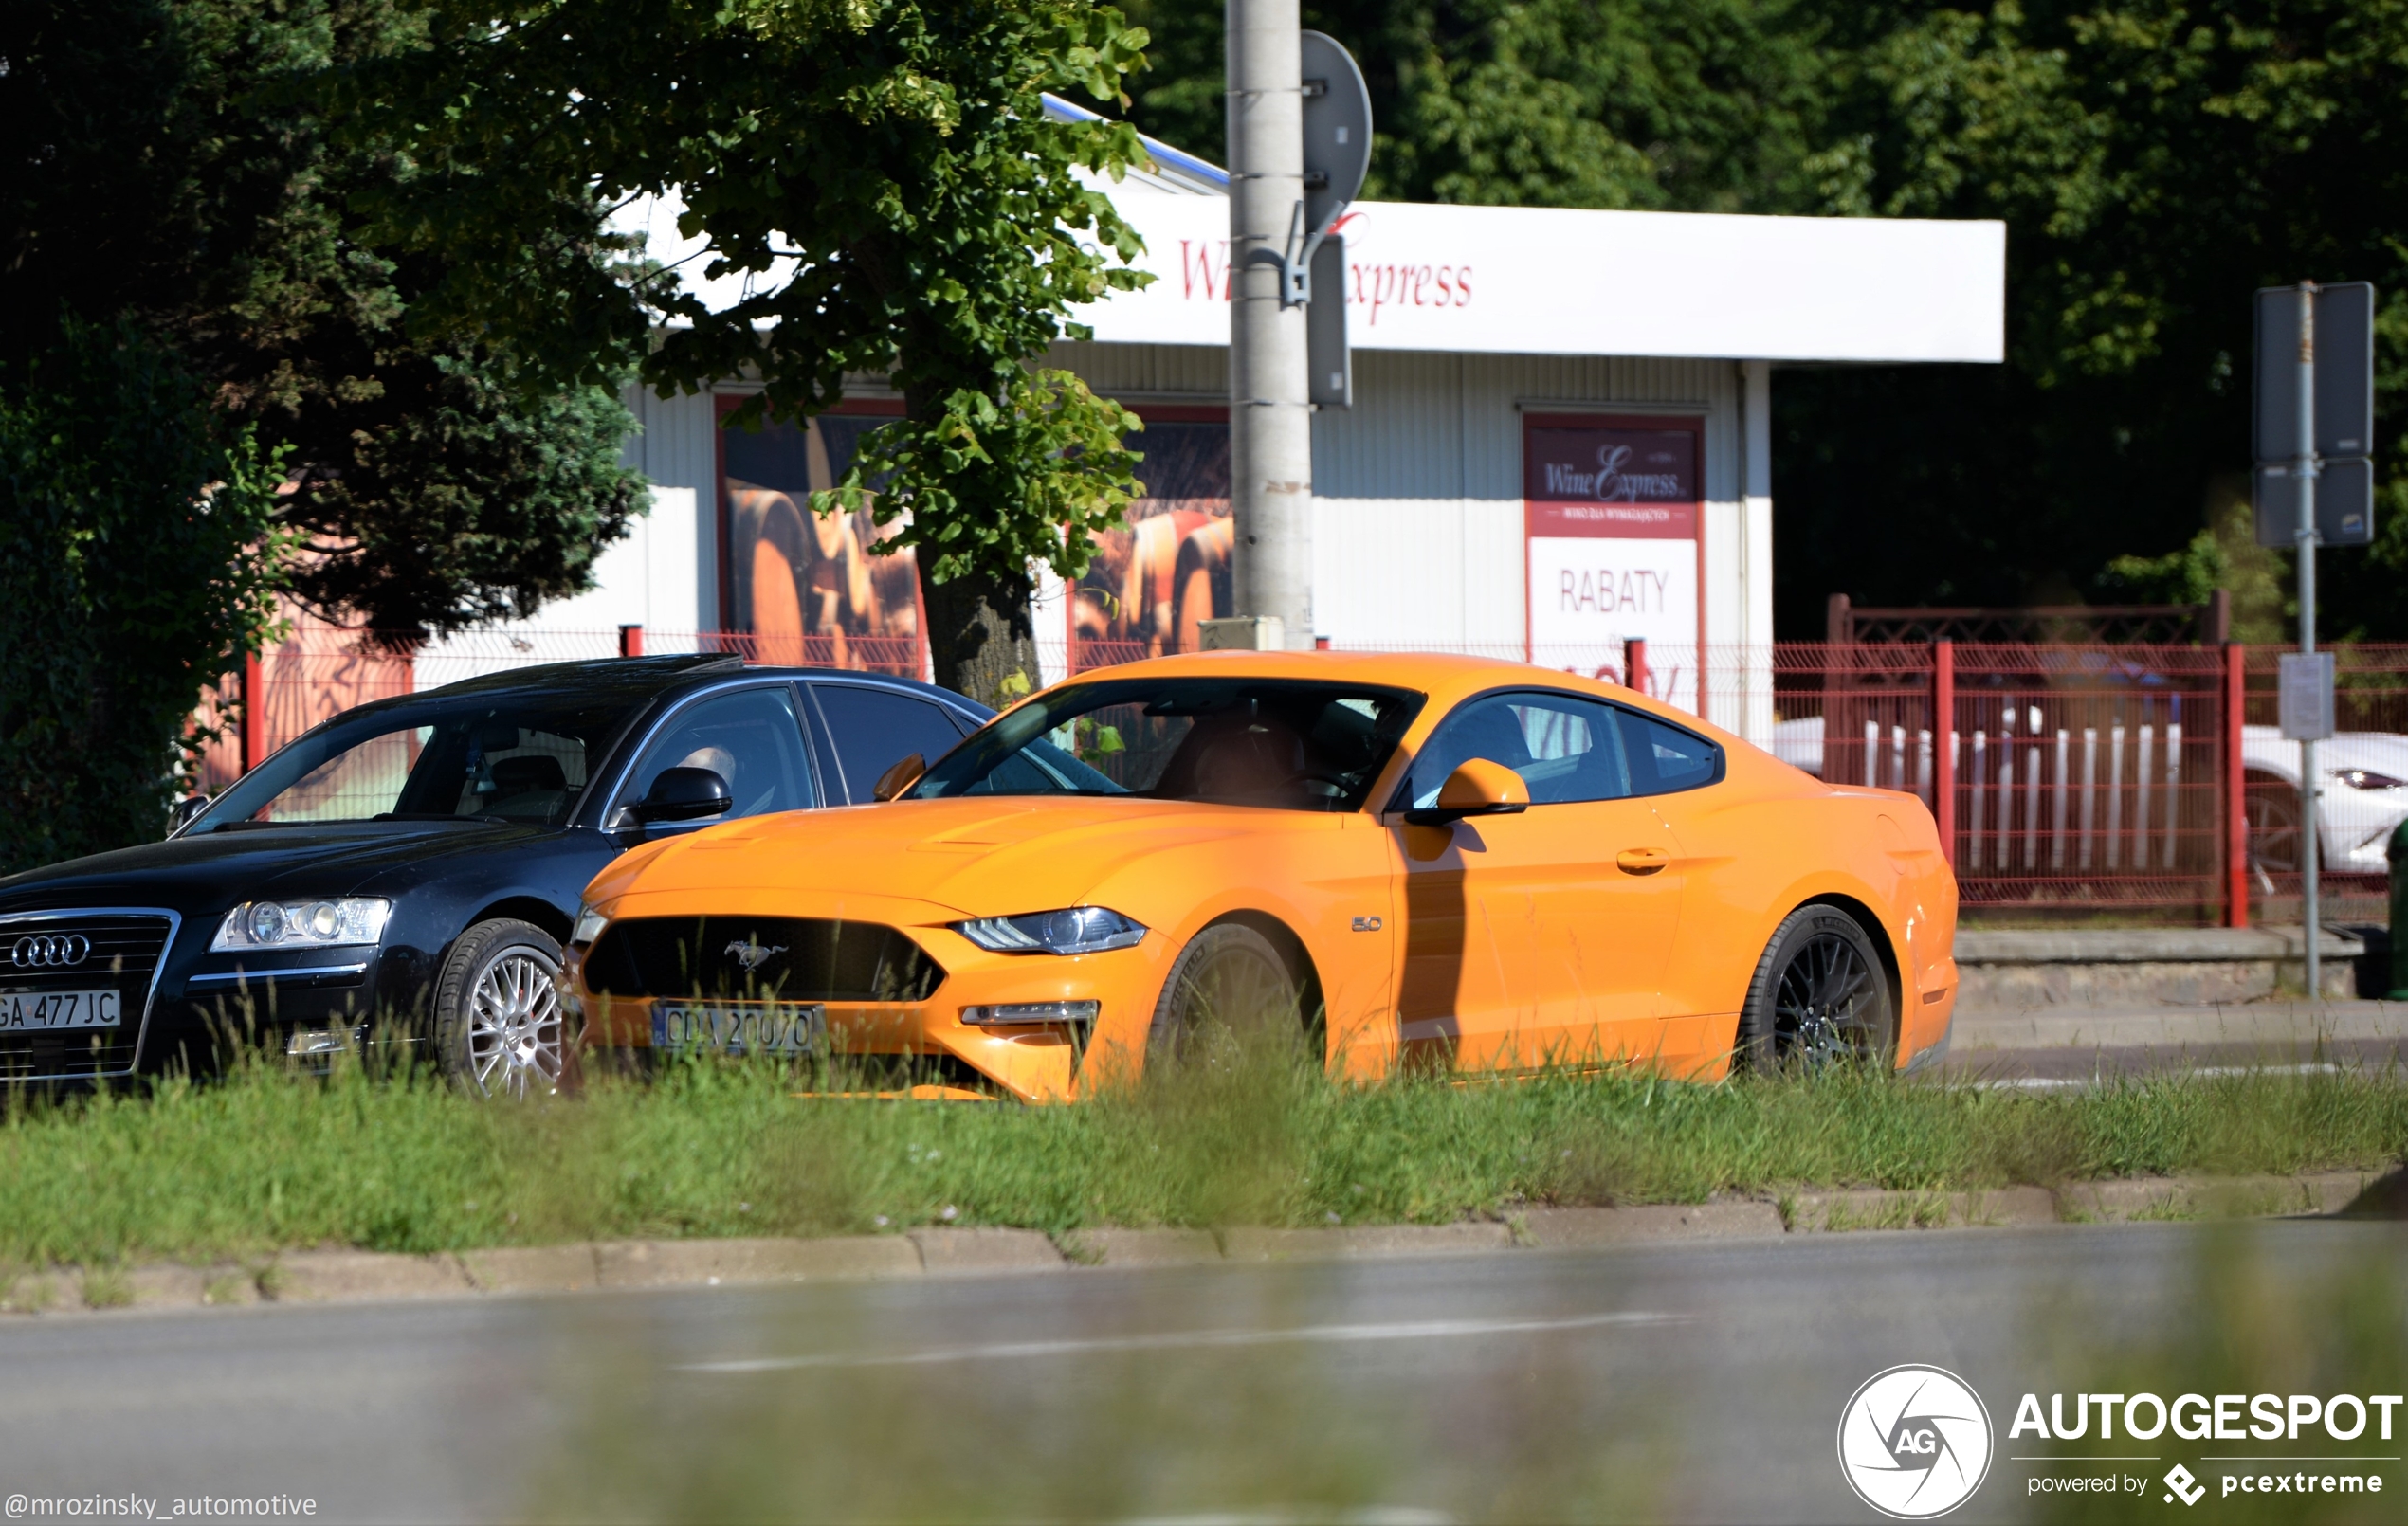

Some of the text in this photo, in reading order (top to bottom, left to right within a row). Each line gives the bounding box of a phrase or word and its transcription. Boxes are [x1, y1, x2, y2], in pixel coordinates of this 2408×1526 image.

[1545, 444, 1678, 504] Wine Express
[1560, 569, 1669, 614] RABATY
[34, 994, 79, 1026] 477
[83, 992, 116, 1024] JC
